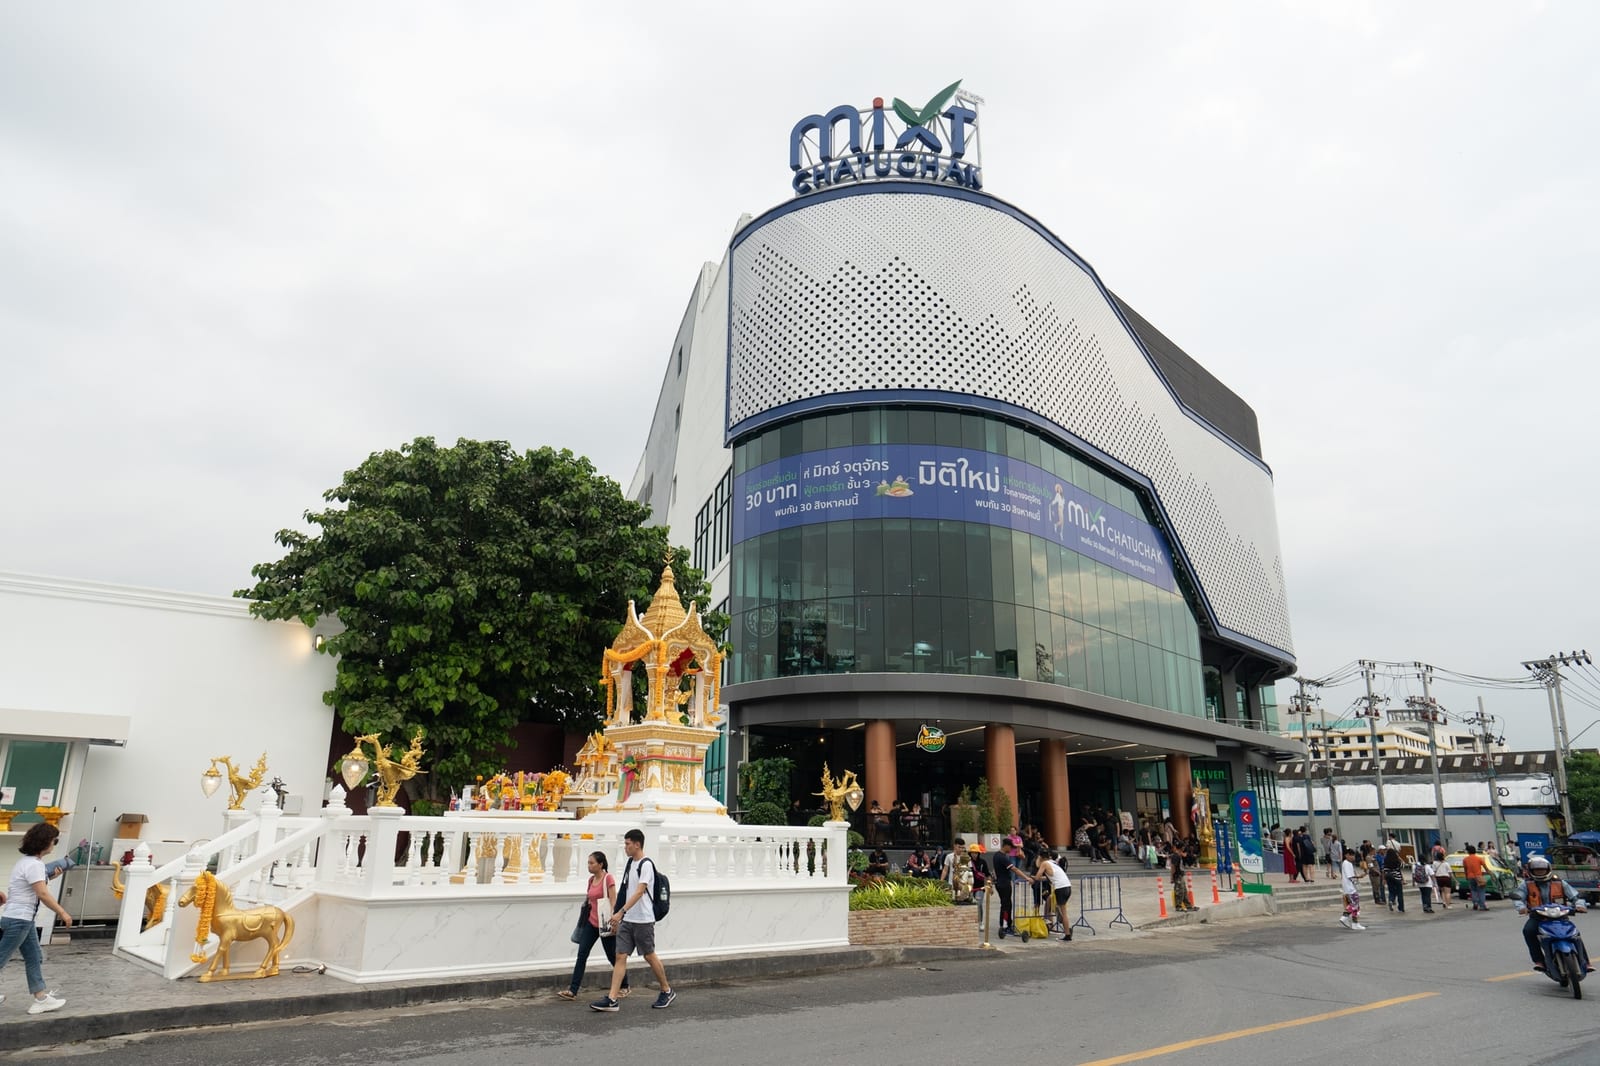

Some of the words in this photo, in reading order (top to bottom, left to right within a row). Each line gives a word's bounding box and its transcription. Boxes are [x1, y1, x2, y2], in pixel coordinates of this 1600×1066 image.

[792, 151, 983, 195] CHATUCHAK
[843, 458, 889, 476] จตุจักร
[919, 457, 1000, 493] มิติใหม่
[862, 479, 871, 488] 3
[746, 491, 762, 511] 30
[766, 483, 797, 503] บาท
[800, 502, 812, 512] 30
[814, 493, 859, 510] สิงหาคมนี้
[1001, 503, 1012, 513] 30
[1107, 527, 1163, 565] CHATUCHAK
